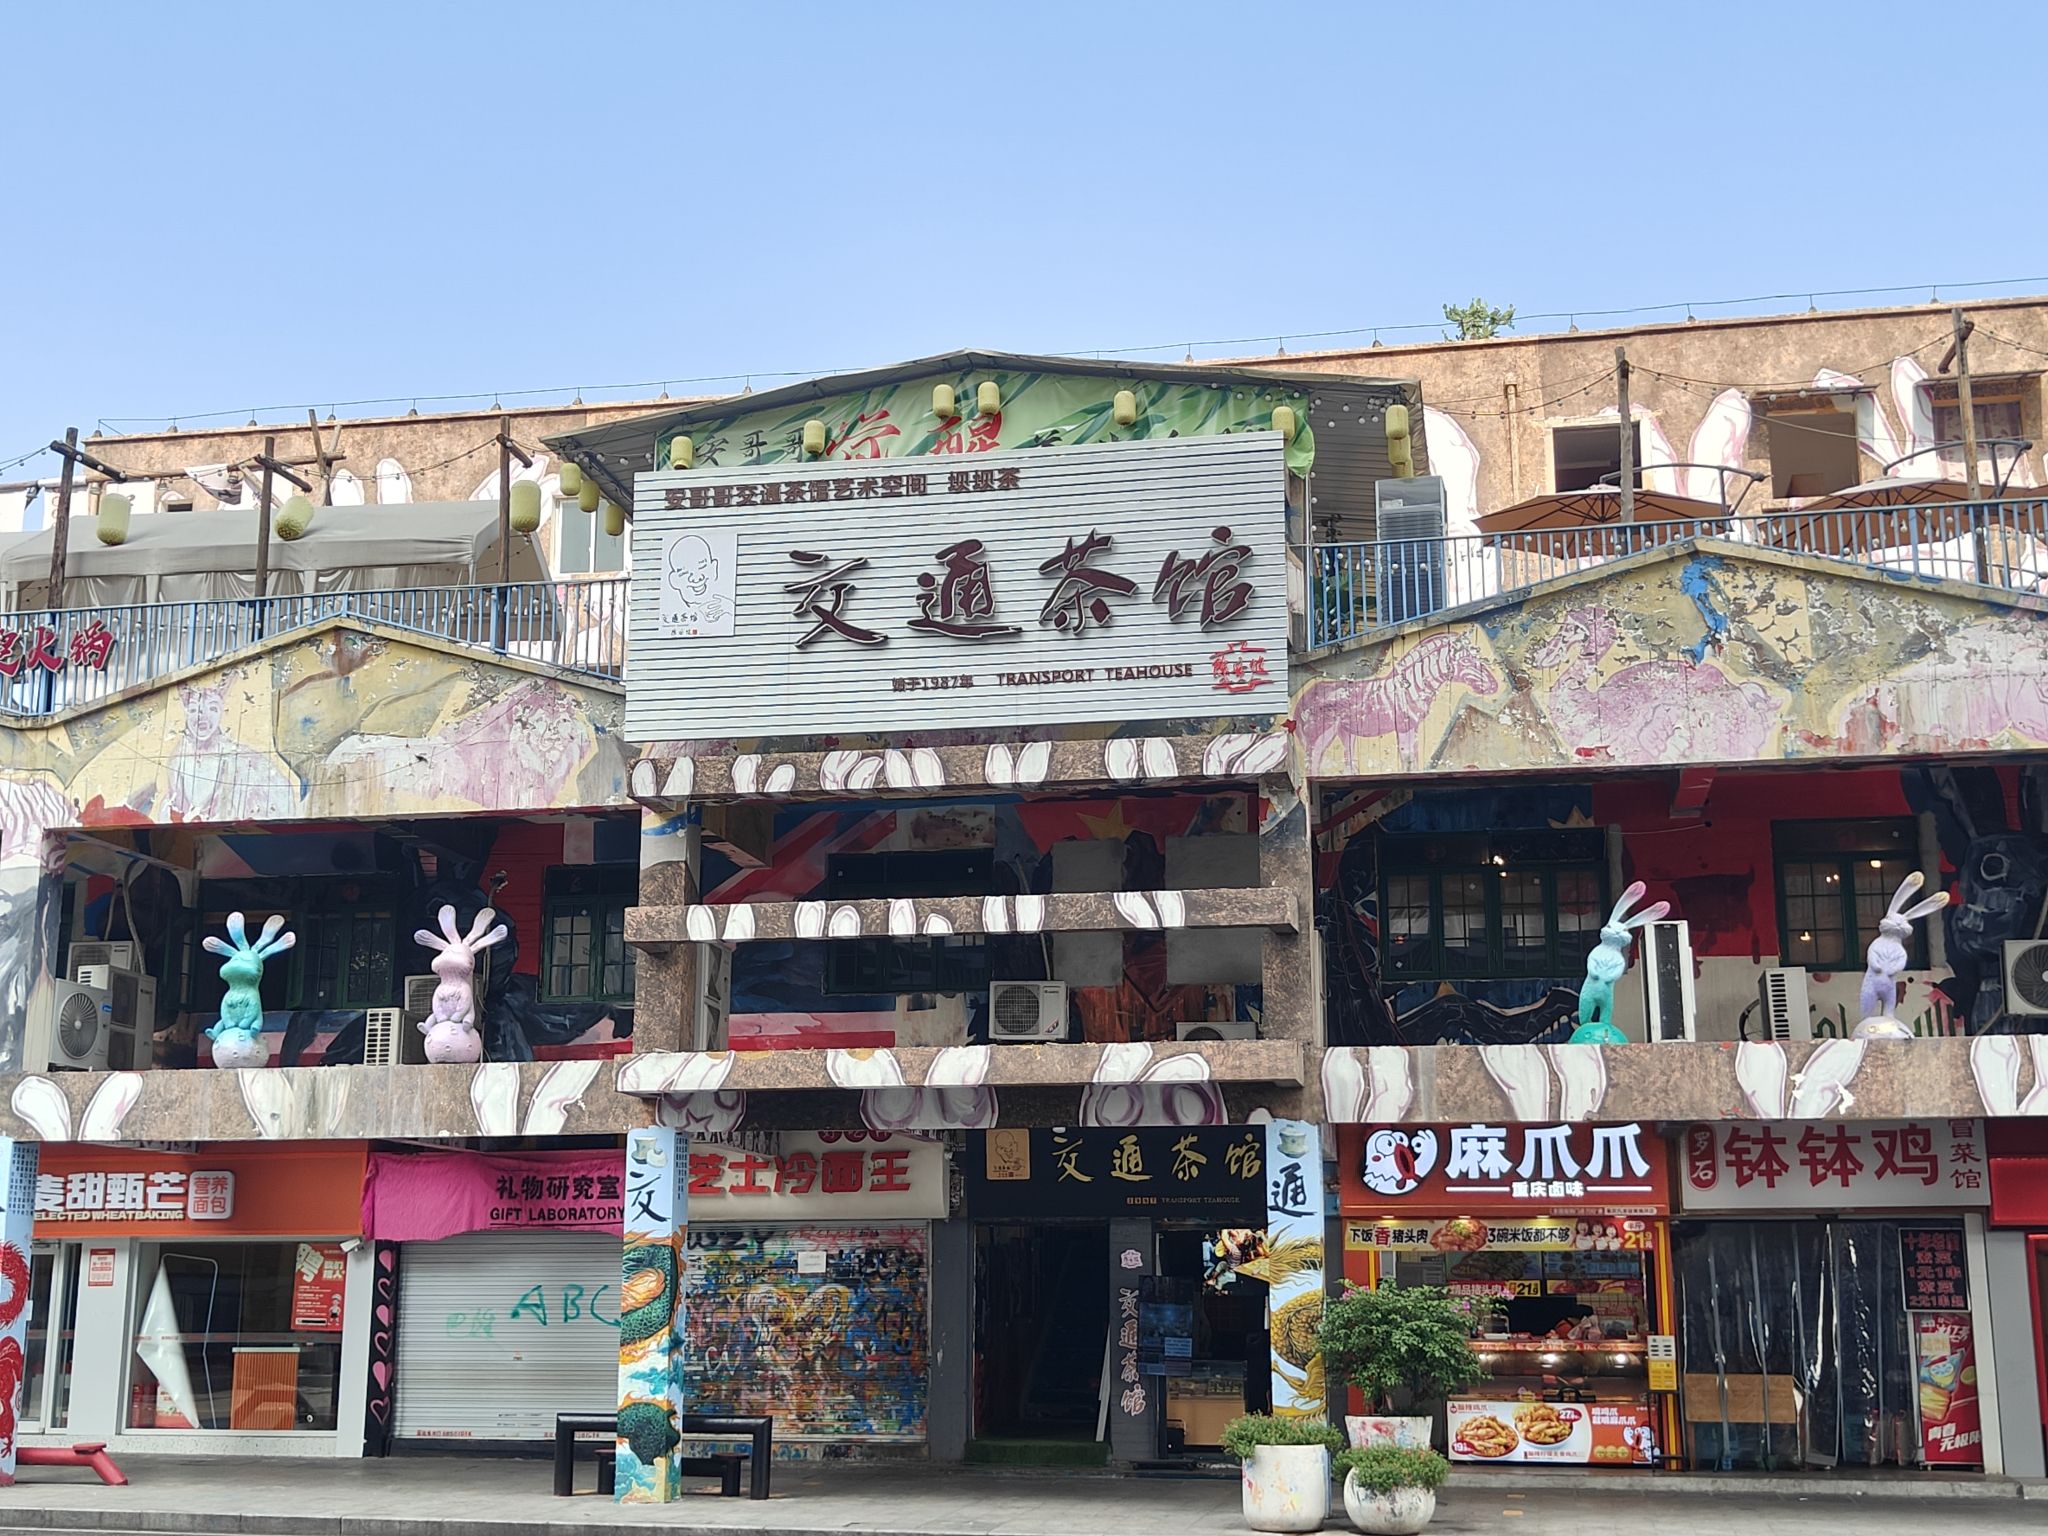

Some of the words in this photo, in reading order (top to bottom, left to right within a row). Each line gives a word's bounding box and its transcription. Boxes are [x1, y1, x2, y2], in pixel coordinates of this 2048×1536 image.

[664, 473, 928, 511] 安哥哥交通茶馆艺术空间
[784, 525, 1256, 650] 交通茶馆
[892, 674, 974, 692] 始于1987年
[997, 668, 1095, 686] TRANSPORT
[1105, 663, 1194, 682] TEAHOUSE
[1052, 1132, 1262, 1183] 交通茶馆
[1445, 1124, 1650, 1179] 麻爪爪
[1723, 1123, 1939, 1189] 钵钵鸡
[1948, 1119, 1982, 1190] 冒菜馆
[193, 1176, 228, 1195] 营养
[496, 1174, 621, 1200] 礼物研究室
[688, 1151, 911, 1195] 芝士冷面王
[193, 1196, 228, 1214] 面包
[1267, 1162, 1317, 1218] 通
[1511, 1181, 1585, 1198] 重庆卤味
[34, 1211, 91, 1221] ELECTED
[490, 1207, 522, 1221] GIFT
[529, 1206, 625, 1221] LABORATORY
[1487, 1226, 1572, 1245] 3碗米饭都不够
[1118, 1288, 1147, 1416] 交通茶馆
